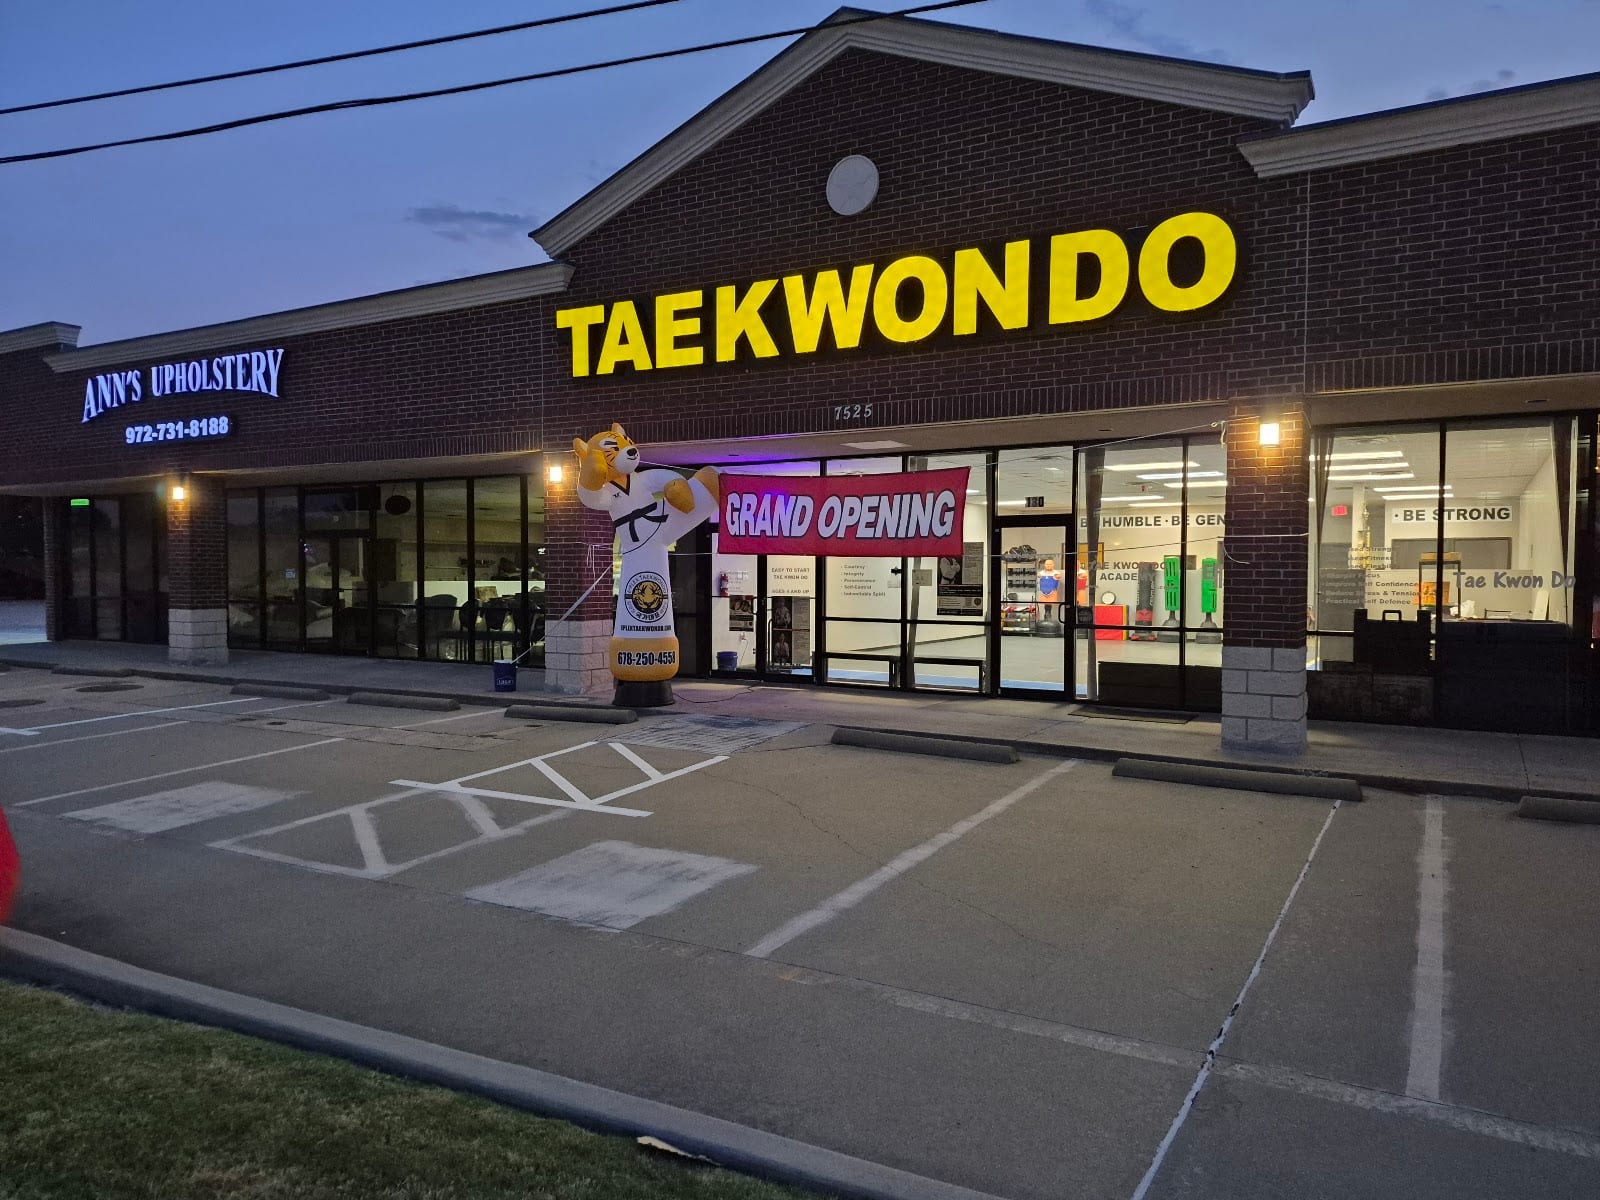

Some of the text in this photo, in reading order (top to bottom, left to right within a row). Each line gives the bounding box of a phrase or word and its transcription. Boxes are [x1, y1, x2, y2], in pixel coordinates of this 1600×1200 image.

[81, 348, 285, 424] ANN'S UPHOLSTERY
[834, 403, 873, 420] 7525
[125, 416, 229, 444] 972-731-8188
[726, 490, 956, 539] GRAND OPENING
[1102, 515, 1161, 527] HUMBLE
[1403, 509, 1425, 521] BE
[1113, 561, 1139, 570] KWO
[1100, 573, 1138, 581] ACADE
[1453, 571, 1487, 589] Tae
[1493, 571, 1543, 589] Kwon
